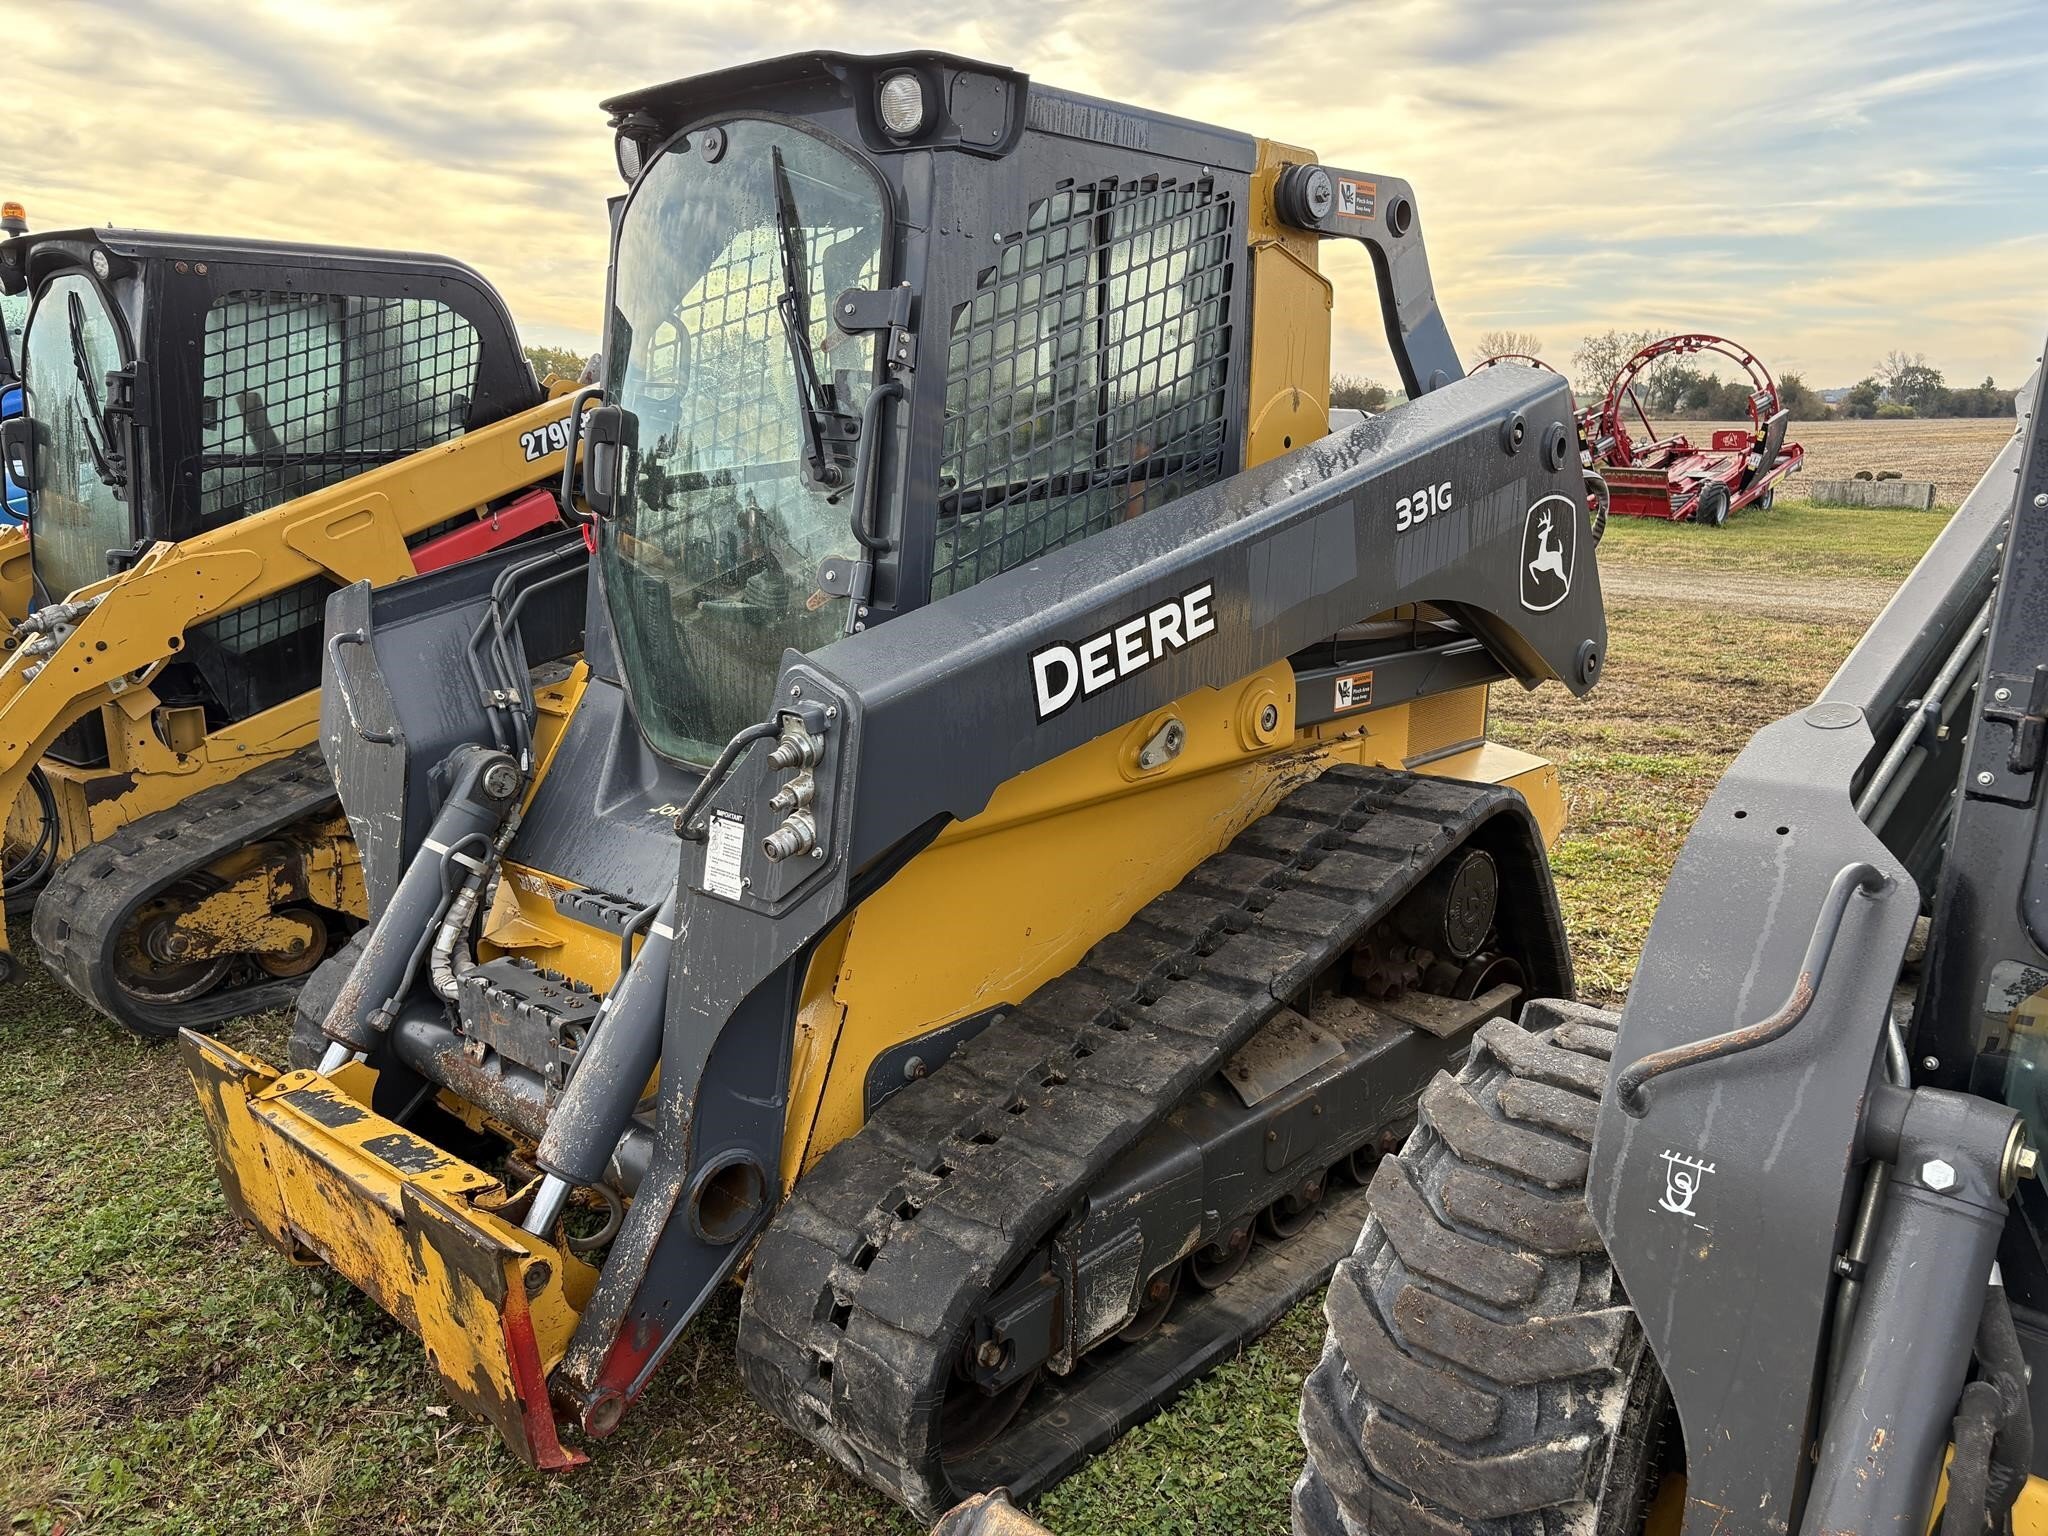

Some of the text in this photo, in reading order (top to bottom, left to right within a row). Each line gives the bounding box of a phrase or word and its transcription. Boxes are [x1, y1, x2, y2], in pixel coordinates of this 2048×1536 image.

[1396, 481, 1452, 531] 331G
[1033, 584, 1215, 717] DEERE
[647, 803, 683, 817] JOH
[716, 809, 744, 822] IMPORTANT
